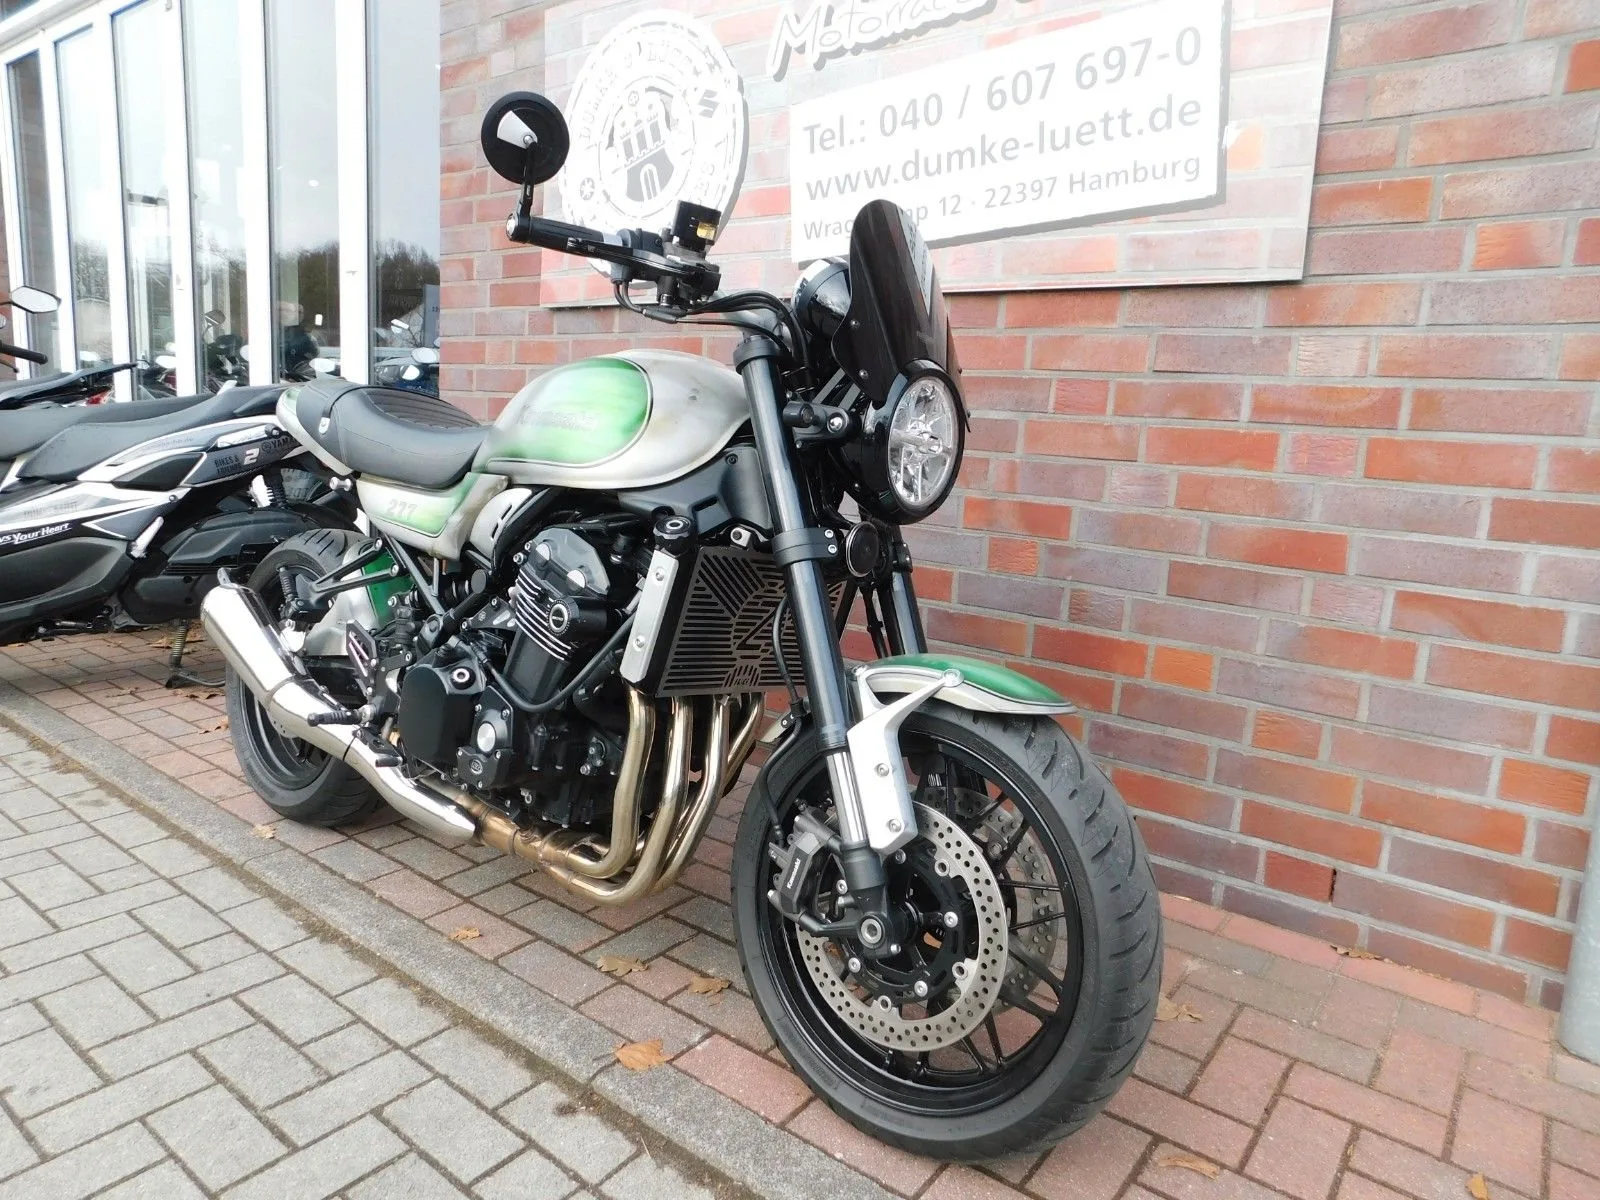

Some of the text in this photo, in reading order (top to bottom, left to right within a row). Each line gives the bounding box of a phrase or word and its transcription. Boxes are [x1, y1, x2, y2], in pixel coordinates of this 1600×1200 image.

[803, 26, 1201, 155] Tel.: 040 / 607 697-0
[805, 94, 1201, 201] www.dumke-luett.de
[938, 194, 963, 217] 12
[984, 176, 1058, 209] 22397
[1069, 156, 1200, 195] Hamburg
[243, 447, 260, 466] 2
[12, 529, 42, 545] Your
[41, 522, 71, 536] Heart
